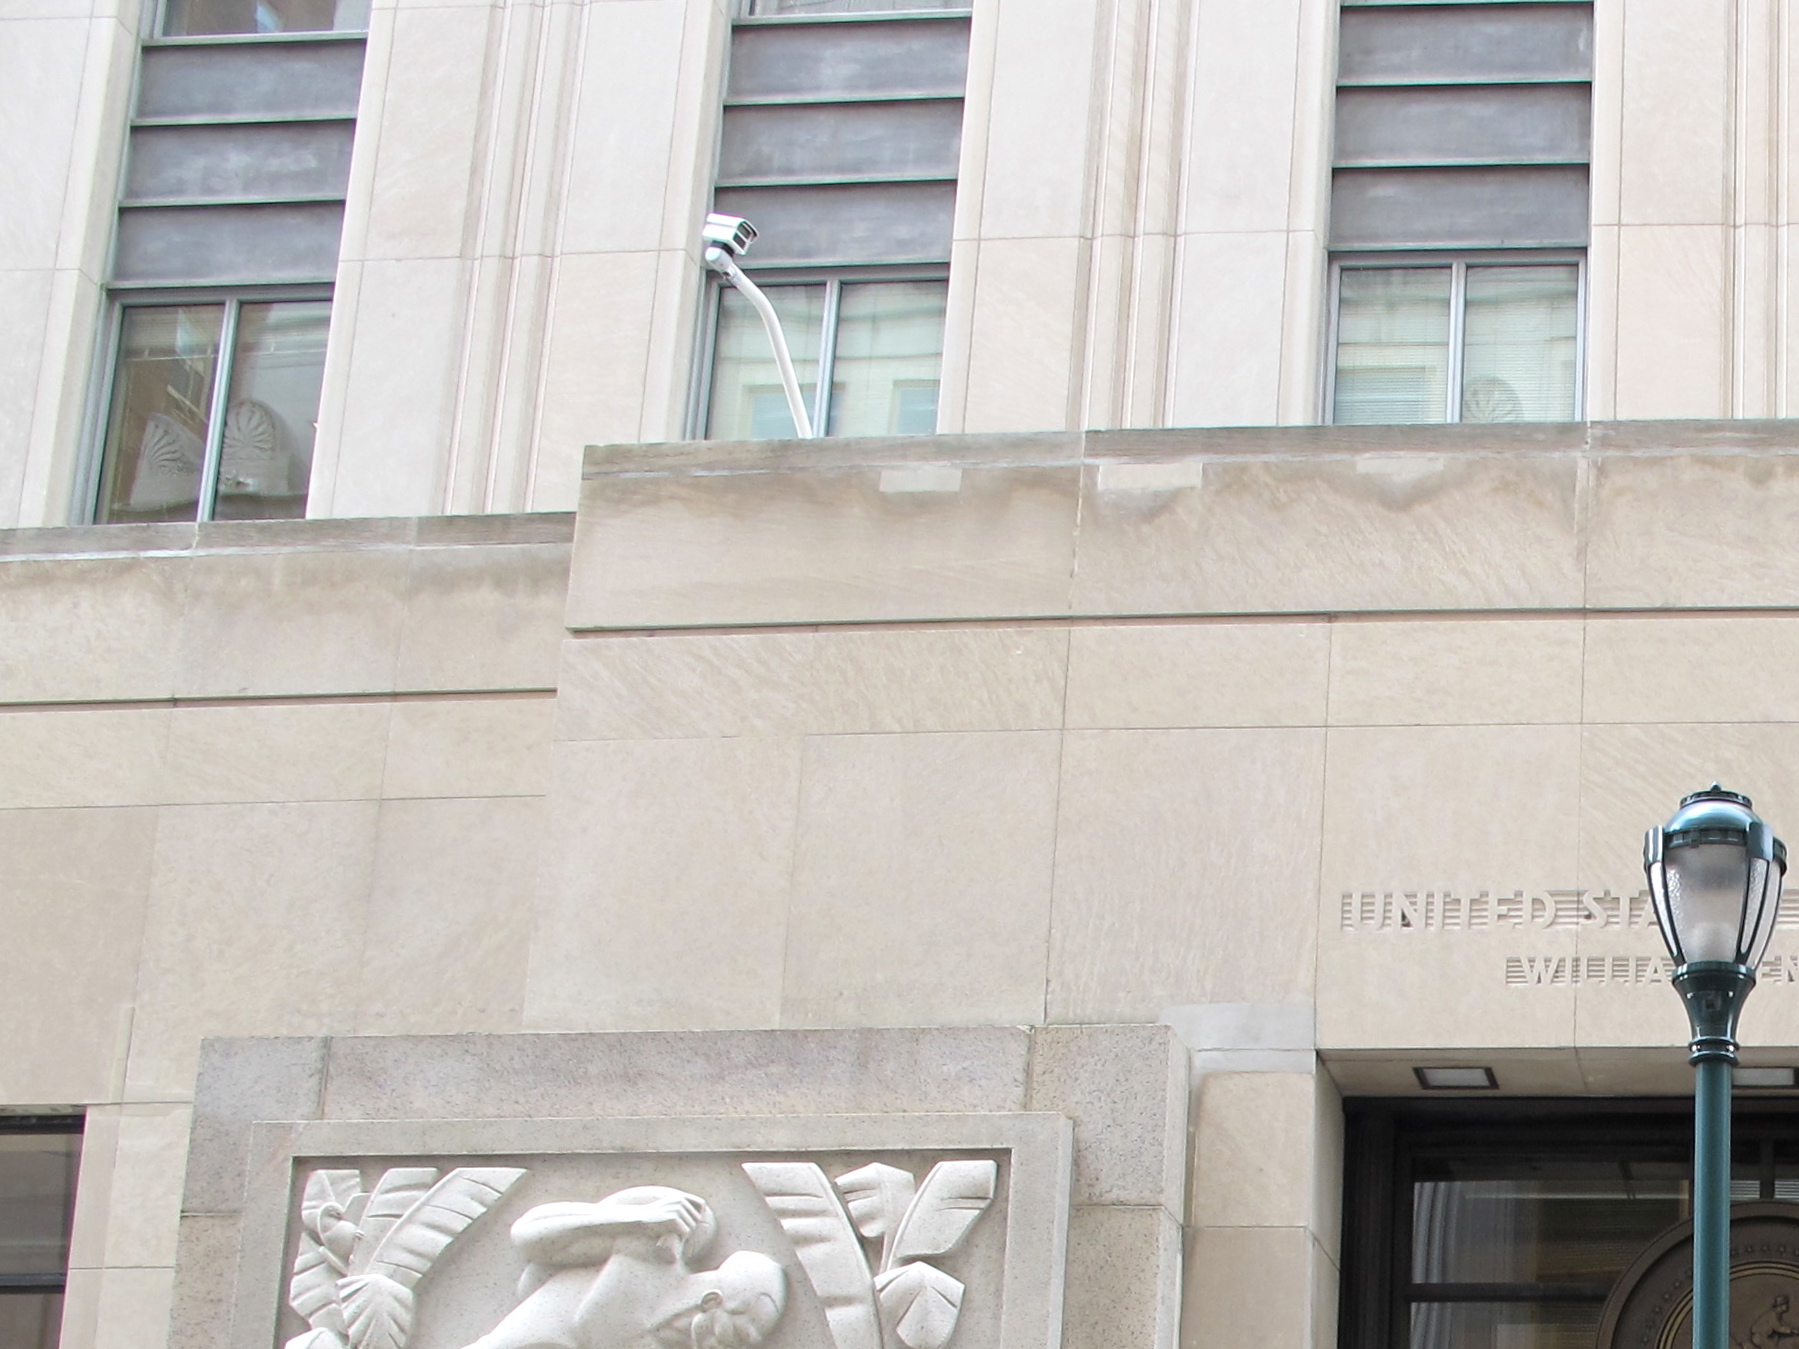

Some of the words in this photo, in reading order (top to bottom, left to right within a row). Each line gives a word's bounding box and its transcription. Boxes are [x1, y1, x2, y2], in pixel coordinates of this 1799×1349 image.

[1351, 890, 1556, 931] UNITED
[1579, 889, 1661, 930] STA
[1517, 956, 1670, 986] WILLIA
